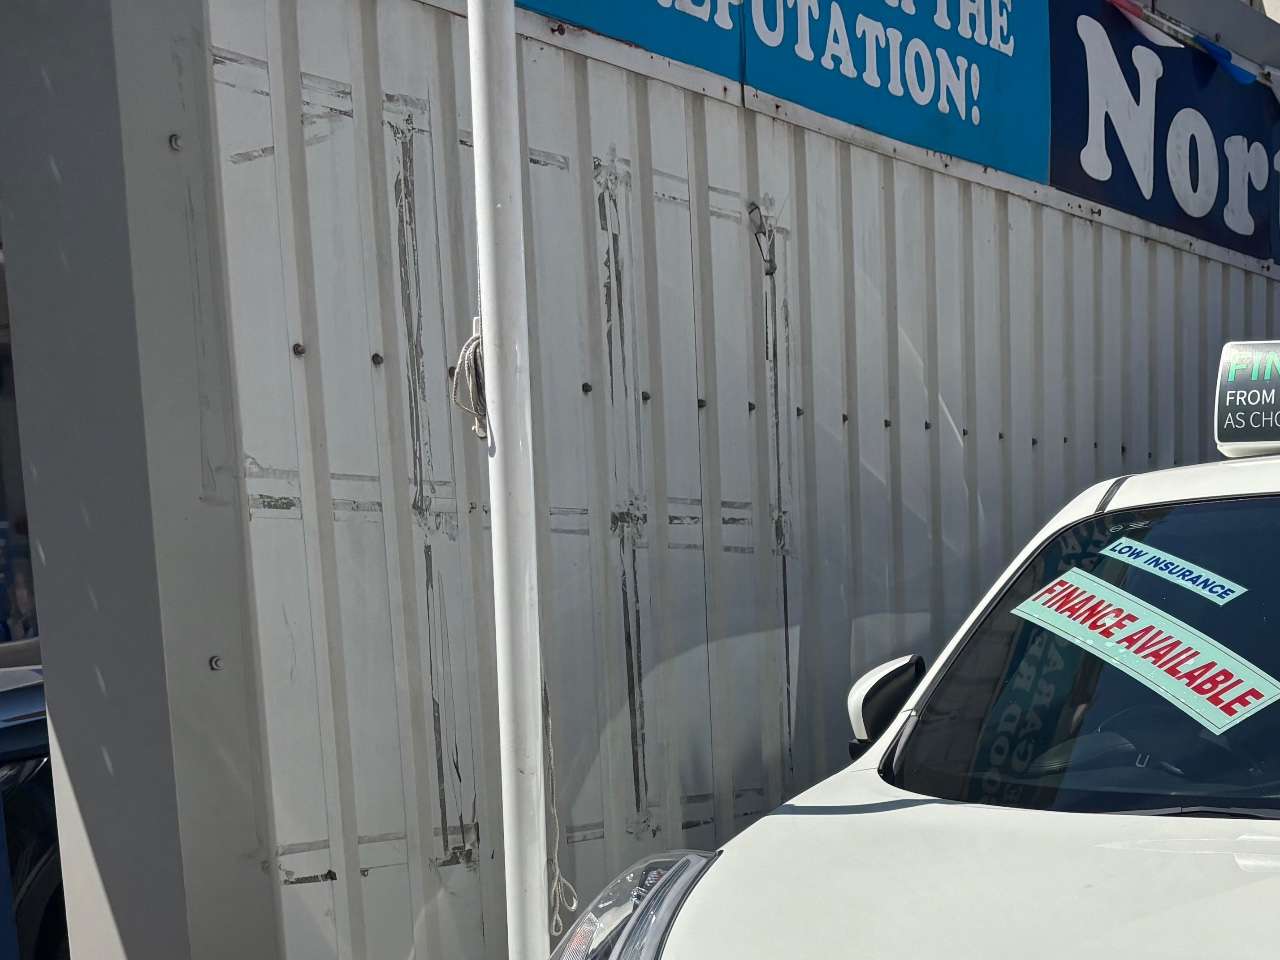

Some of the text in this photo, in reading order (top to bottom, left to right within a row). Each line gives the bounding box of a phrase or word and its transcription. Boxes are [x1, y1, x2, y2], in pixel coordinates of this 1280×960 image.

[657, 0, 981, 126] UTATION!
[1224, 412, 1246, 429] AS
[1226, 389, 1275, 406] FROM
[1110, 542, 1144, 561] LOW
[1144, 555, 1236, 600] INSURANCE
[1033, 580, 1139, 639] FINANCE
[1116, 624, 1265, 717] AVAILABLE
